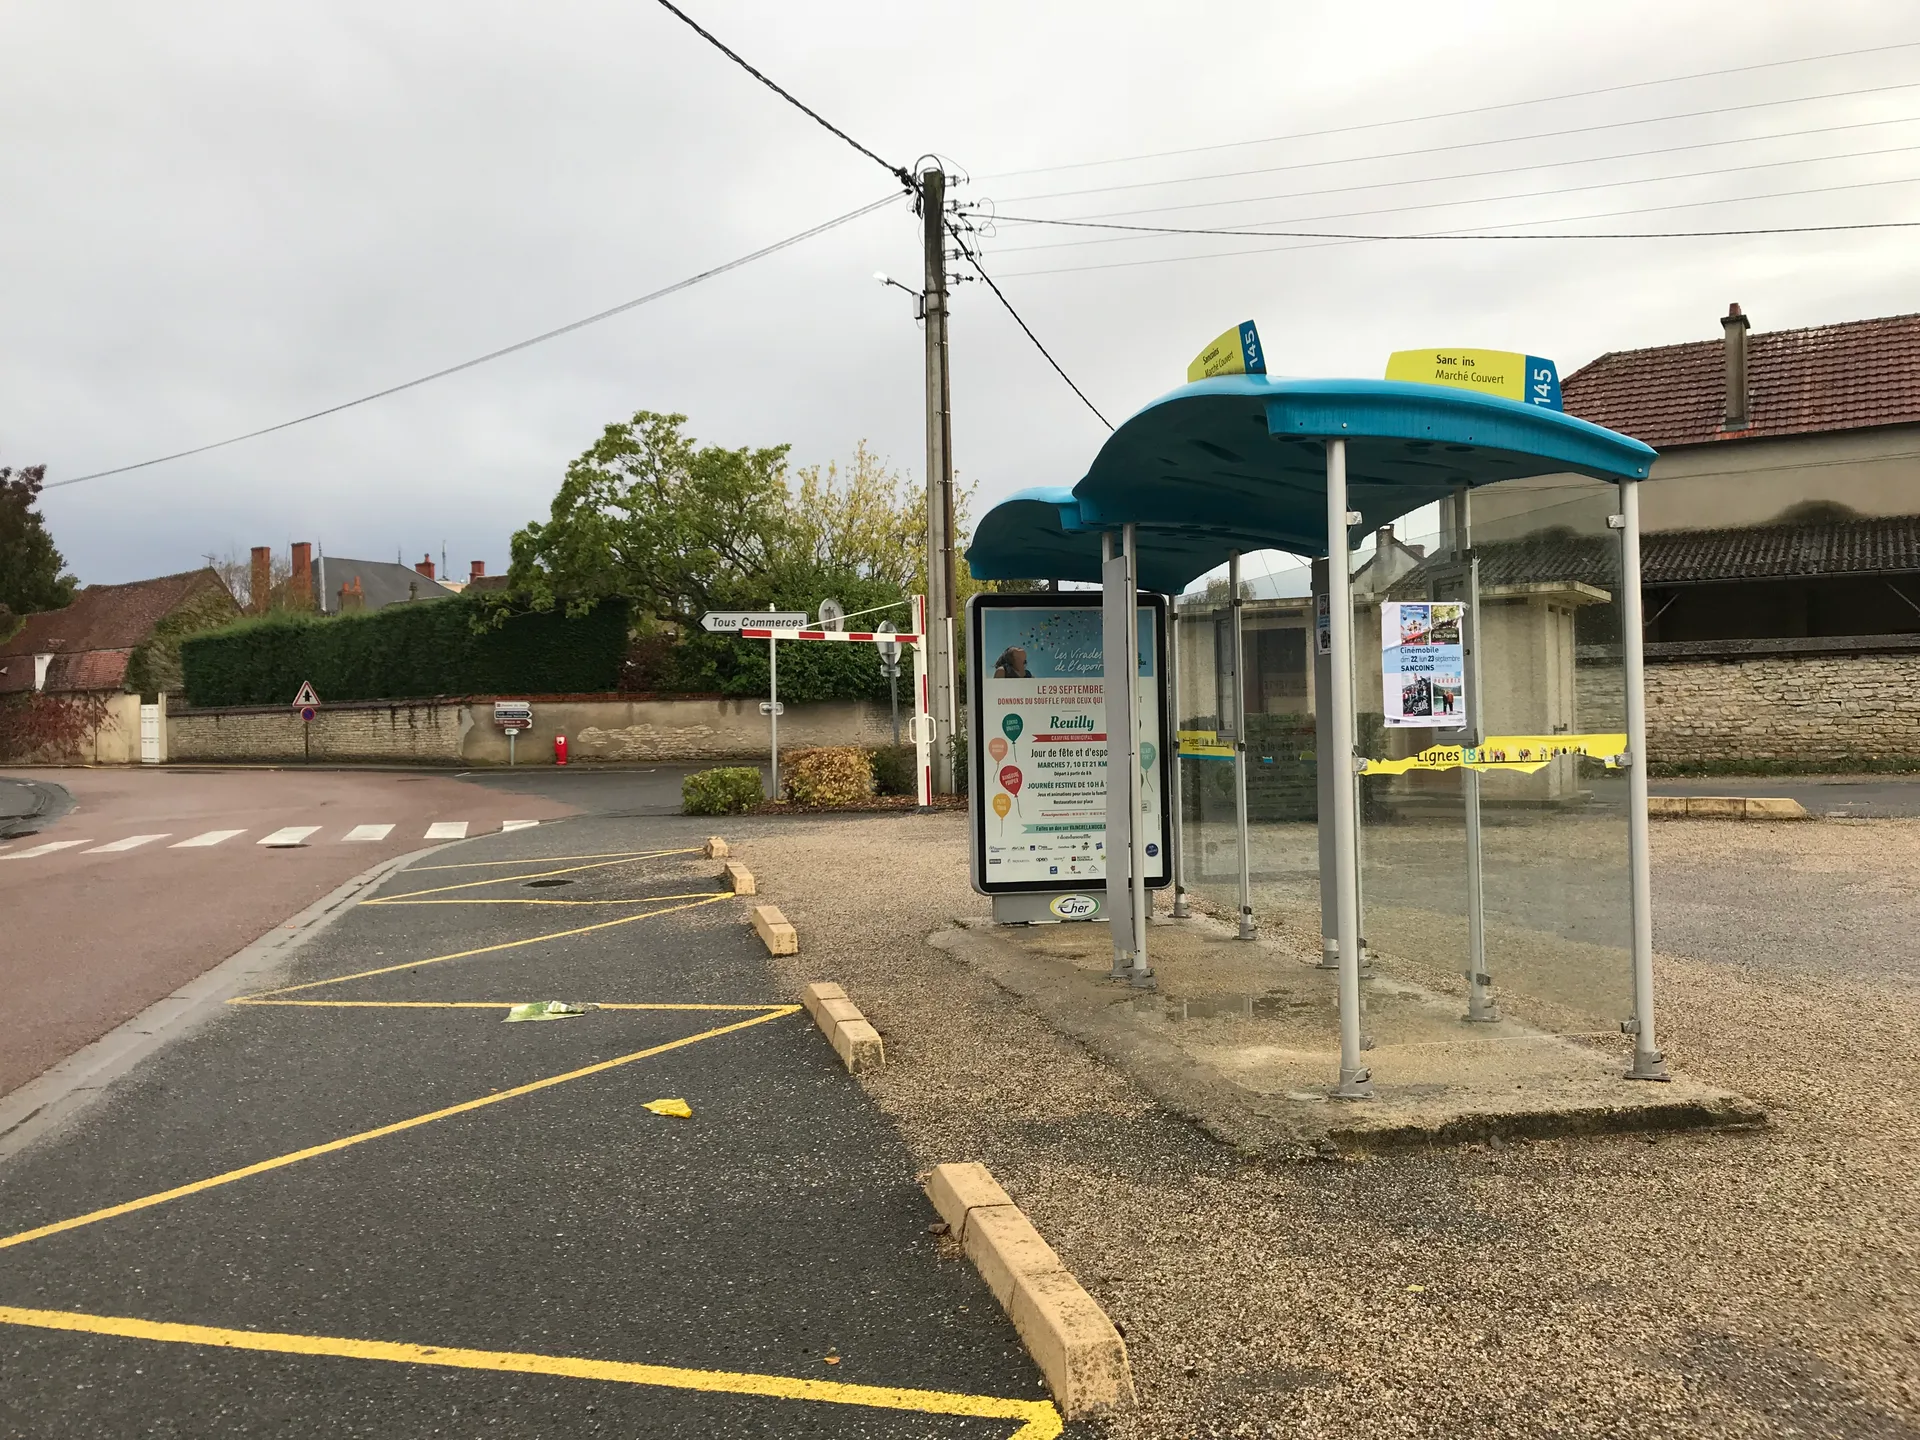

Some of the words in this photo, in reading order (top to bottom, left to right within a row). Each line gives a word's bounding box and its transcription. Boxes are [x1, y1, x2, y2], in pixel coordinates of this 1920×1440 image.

[1202, 347, 1220, 365] Sancoins
[1244, 330, 1258, 368] 145
[1219, 351, 1234, 368] Couvert
[1435, 370, 1468, 382] Marché
[1470, 372, 1504, 384] Couvert
[1533, 368, 1552, 405] 145
[712, 617, 736, 627] Tous
[741, 617, 804, 628] Commerces
[1054, 648, 1067, 659] Les
[1070, 648, 1102, 659] Virades
[1054, 660, 1066, 672] de
[1068, 660, 1104, 674] l'espoir
[1037, 686, 1046, 694] LE
[1048, 686, 1057, 694] 29
[1059, 685, 1104, 694] SEPTEMBRE
[1050, 715, 1094, 732] Reuilly
[1031, 749, 1046, 758] Jour
[1048, 749, 1057, 757] de
[1059, 748, 1074, 757] fête
[1076, 748, 1083, 757] et
[1417, 751, 1459, 765] Lignes
[1060, 898, 1089, 914] Cher
